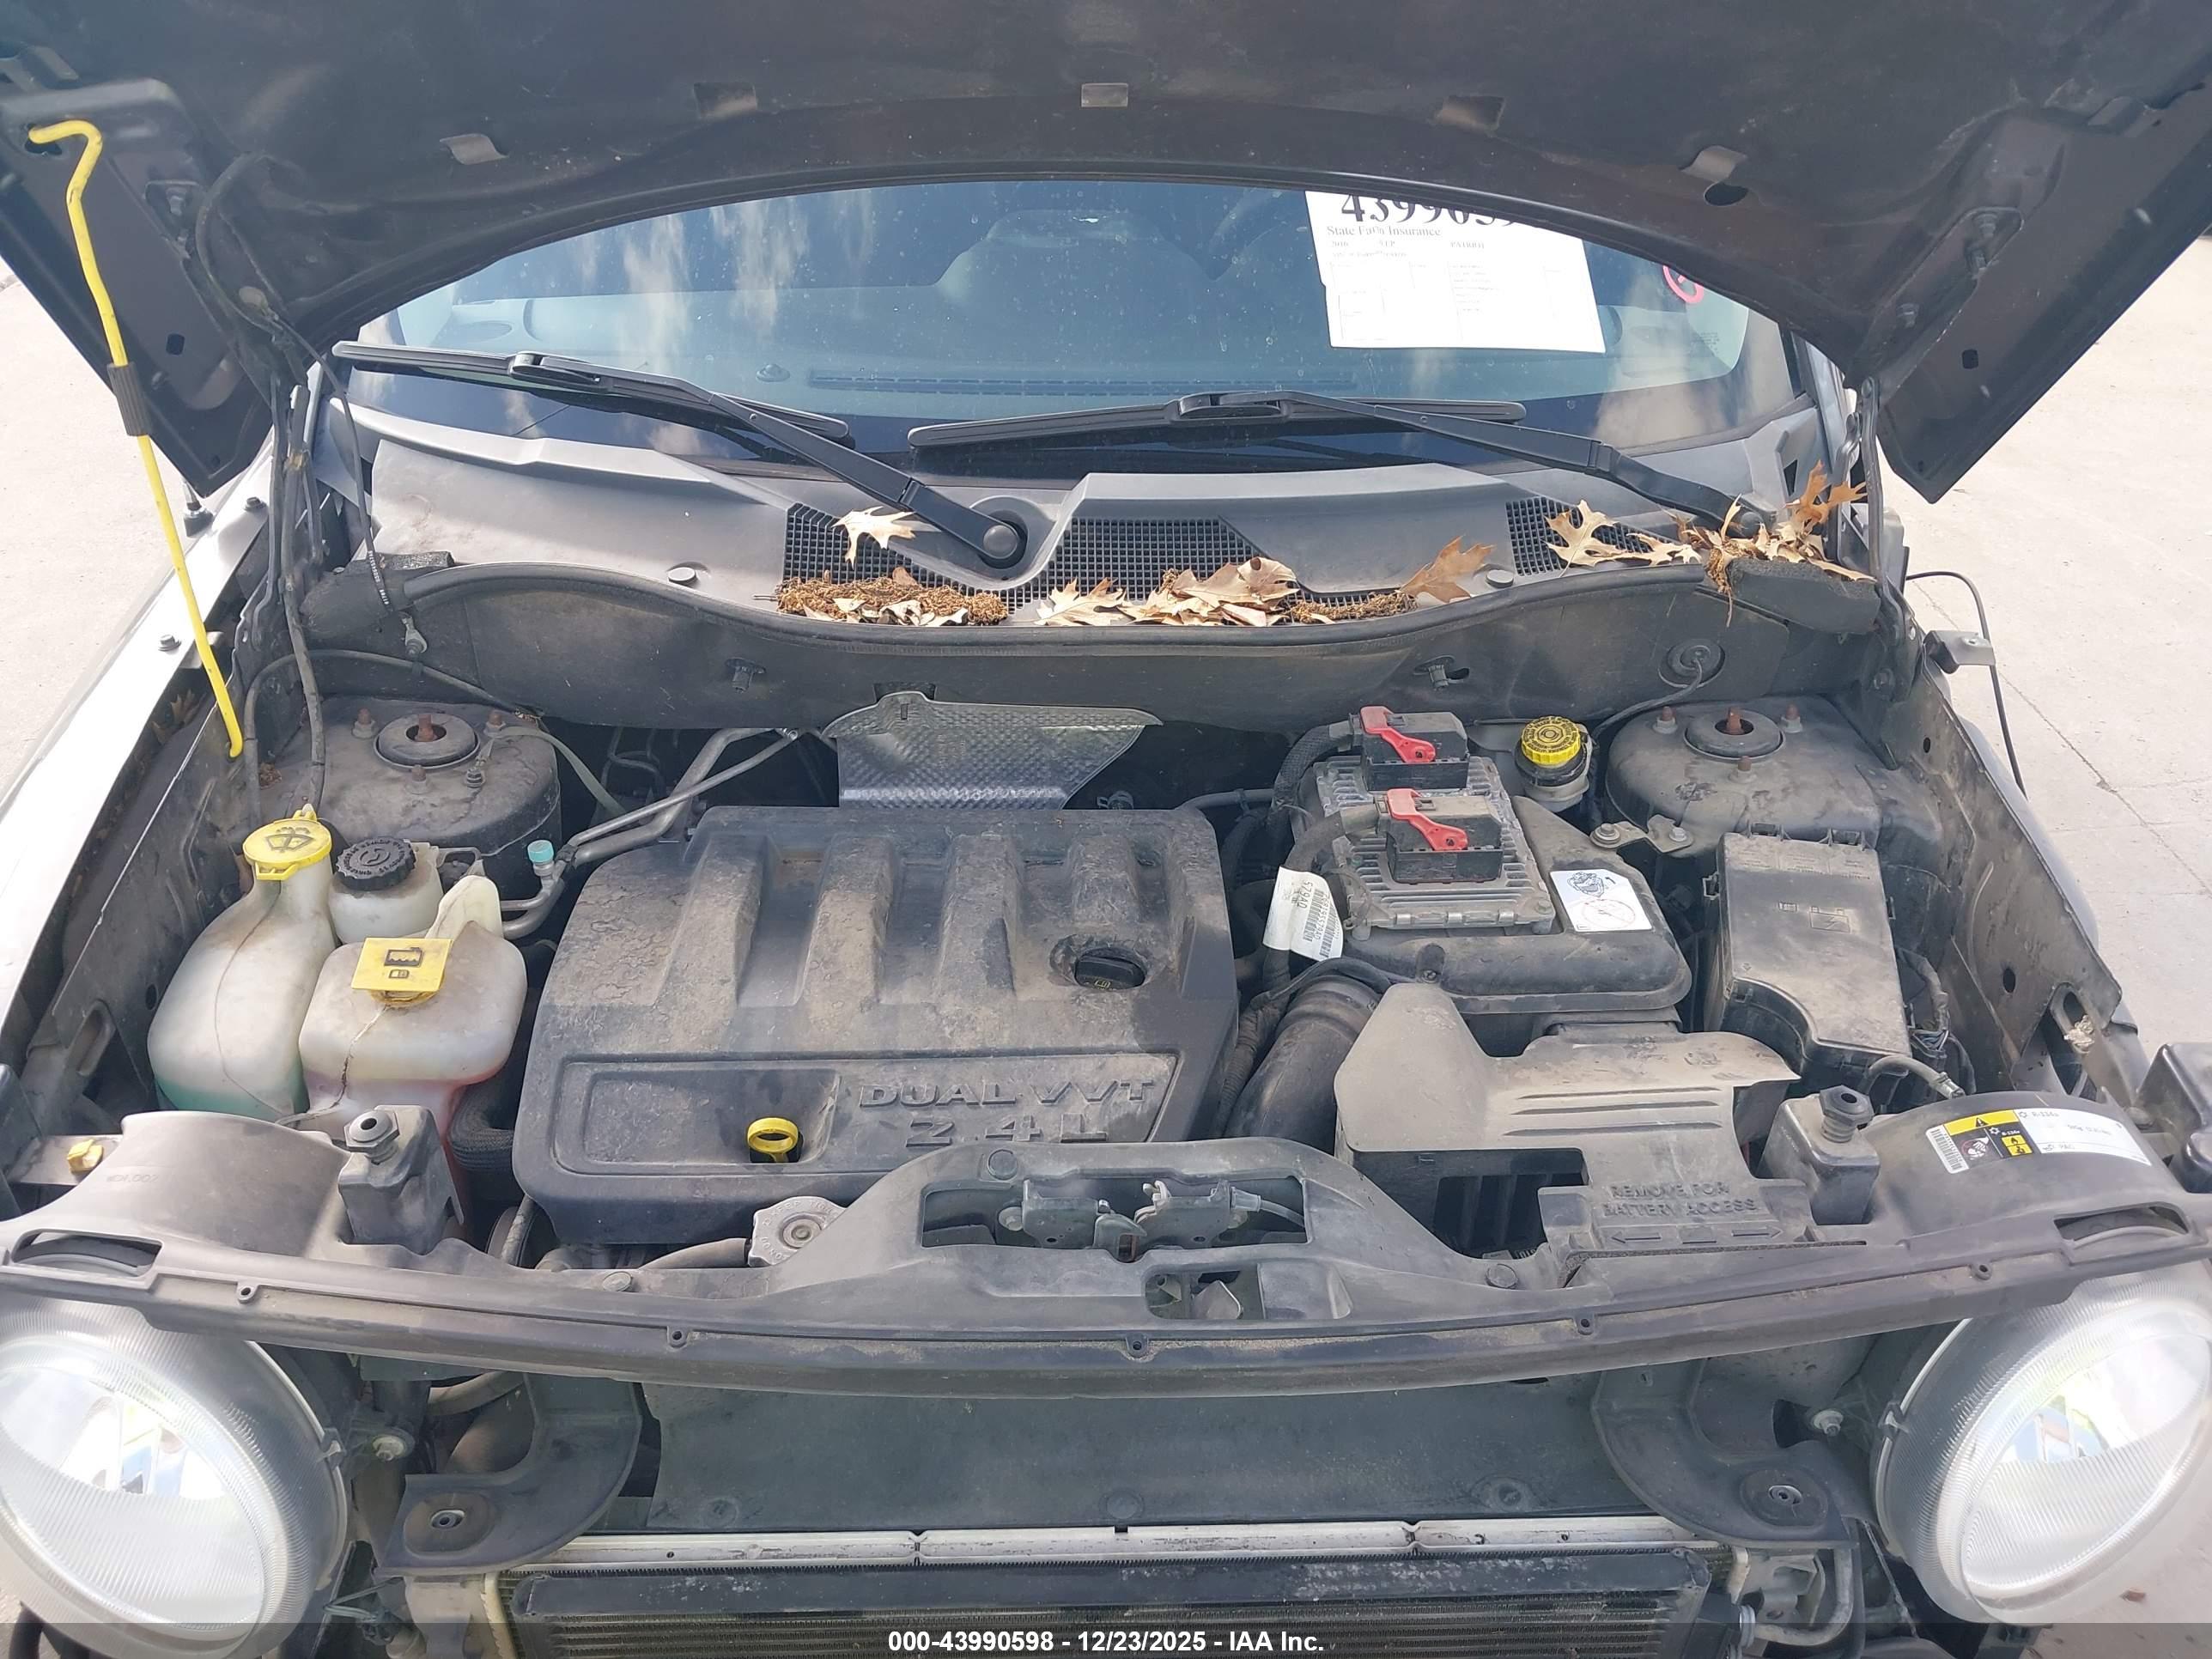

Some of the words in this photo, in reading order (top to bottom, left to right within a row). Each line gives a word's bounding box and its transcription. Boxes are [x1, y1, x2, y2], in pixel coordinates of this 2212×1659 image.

[1327, 226, 1354, 235] State
[1389, 226, 1442, 237] Insurance
[859, 1084, 1017, 1107] DUAL
[1031, 1080, 1155, 1104] VVT
[905, 1113, 1108, 1148] 2.4L
[1608, 1183, 1685, 1198] REMOVE
[1692, 1182, 1730, 1194] FOR
[1602, 1202, 1678, 1217] BATTERY
[1686, 1199, 1757, 1215] ACCESS
